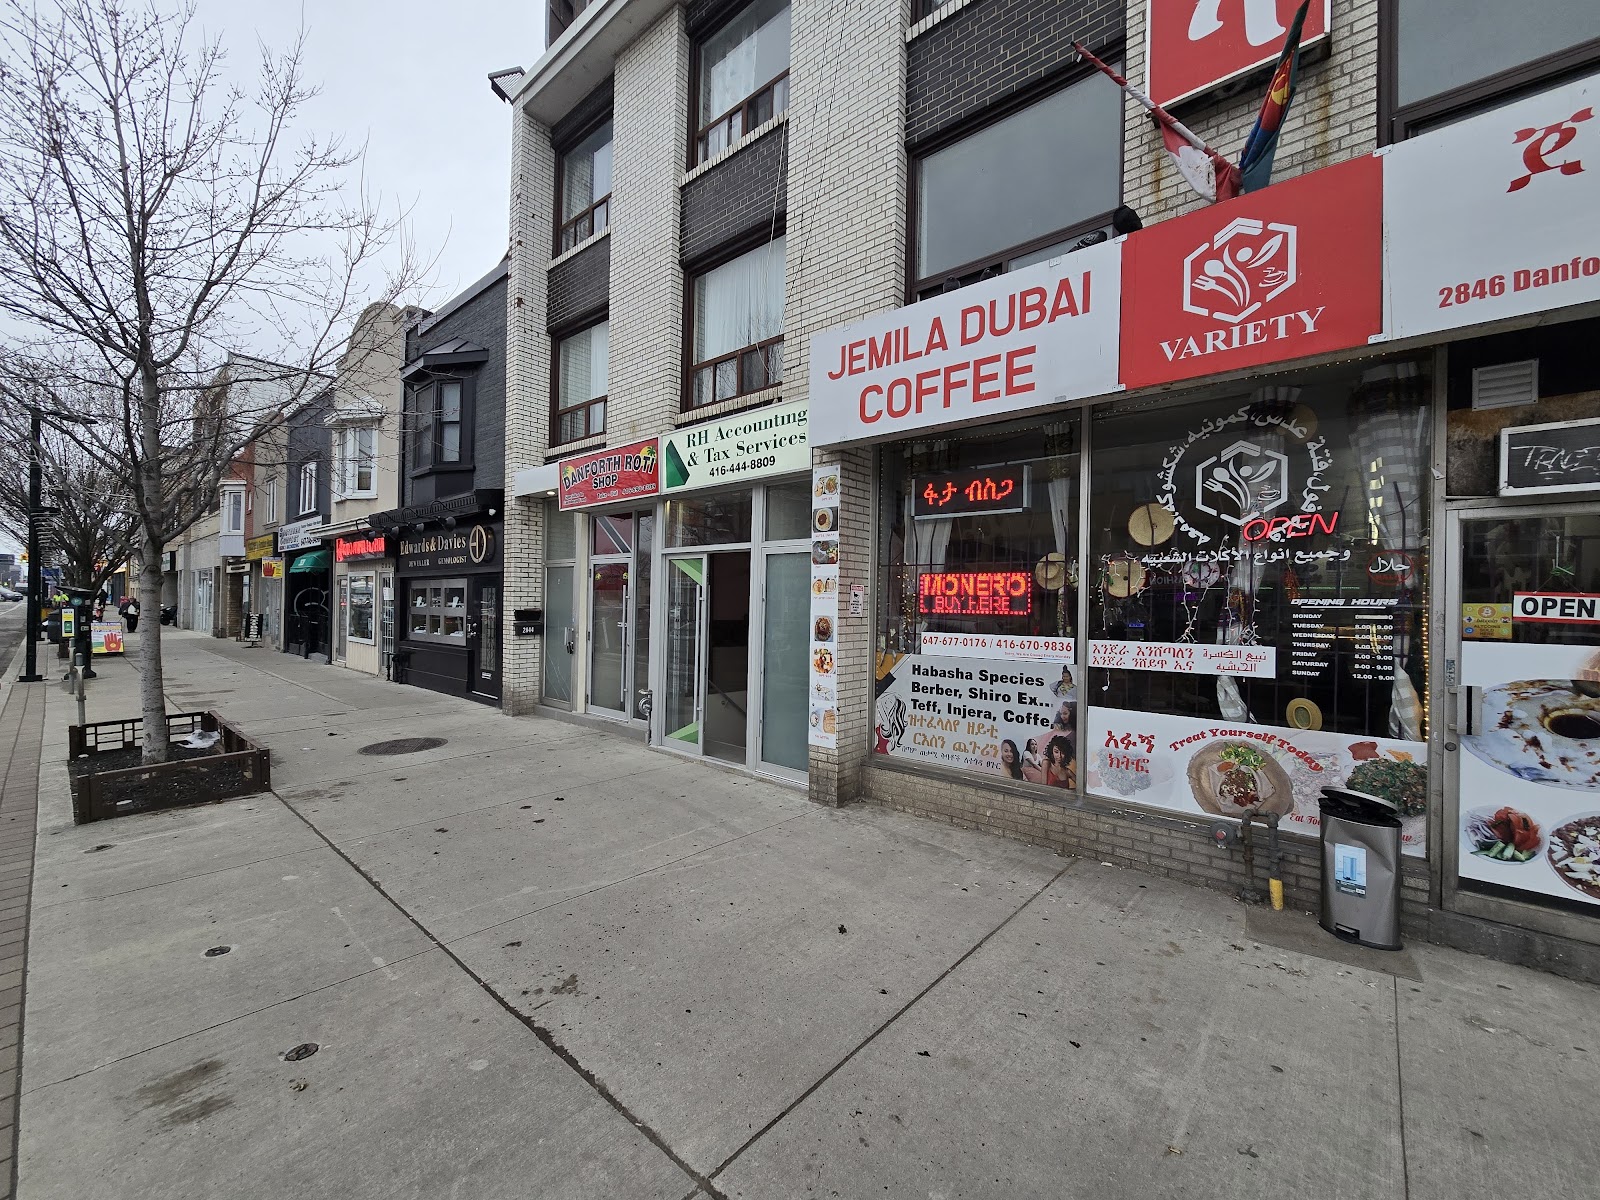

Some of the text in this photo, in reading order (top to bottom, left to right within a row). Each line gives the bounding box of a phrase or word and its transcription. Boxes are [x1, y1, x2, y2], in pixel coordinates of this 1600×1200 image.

[1439, 274, 1505, 308] 2846
[828, 271, 1091, 381] JEMILA DUBAI
[1159, 306, 1325, 362] VARIETY
[859, 345, 1036, 423] COFFEE
[687, 408, 808, 448] RH Accounting
[687, 431, 807, 467] & Tax Services
[563, 454, 656, 491] DANFORTH ROTI
[709, 456, 776, 478] 416-444-8809
[592, 473, 618, 489] SHOP
[1243, 512, 1339, 542] OPEN
[400, 537, 429, 555] Edwards
[430, 537, 436, 548] &
[438, 534, 466, 551] Davies
[409, 556, 467, 567] JEWELLER GEMOLOGIST
[1369, 556, 1410, 573] حلال
[923, 576, 1026, 596] MONERO
[935, 596, 1010, 612] BUY HERE
[1290, 598, 1399, 606] OPENING HOURS
[1521, 597, 1596, 618] OPEN
[922, 636, 987, 648] 647-677-0176
[996, 639, 1072, 652] 416-670-9836
[1203, 648, 1267, 662] نبيع الكسرة
[1292, 660, 1329, 668] SATURDAY
[912, 664, 1045, 687] Habasha Species
[912, 681, 962, 699] Berber,
[968, 687, 1012, 703] Shiro
[911, 698, 941, 714] Teff,
[947, 702, 997, 722] Injera,
[1170, 728, 1324, 772] Treat Yourself Today
[1290, 812, 1304, 822] Eat
